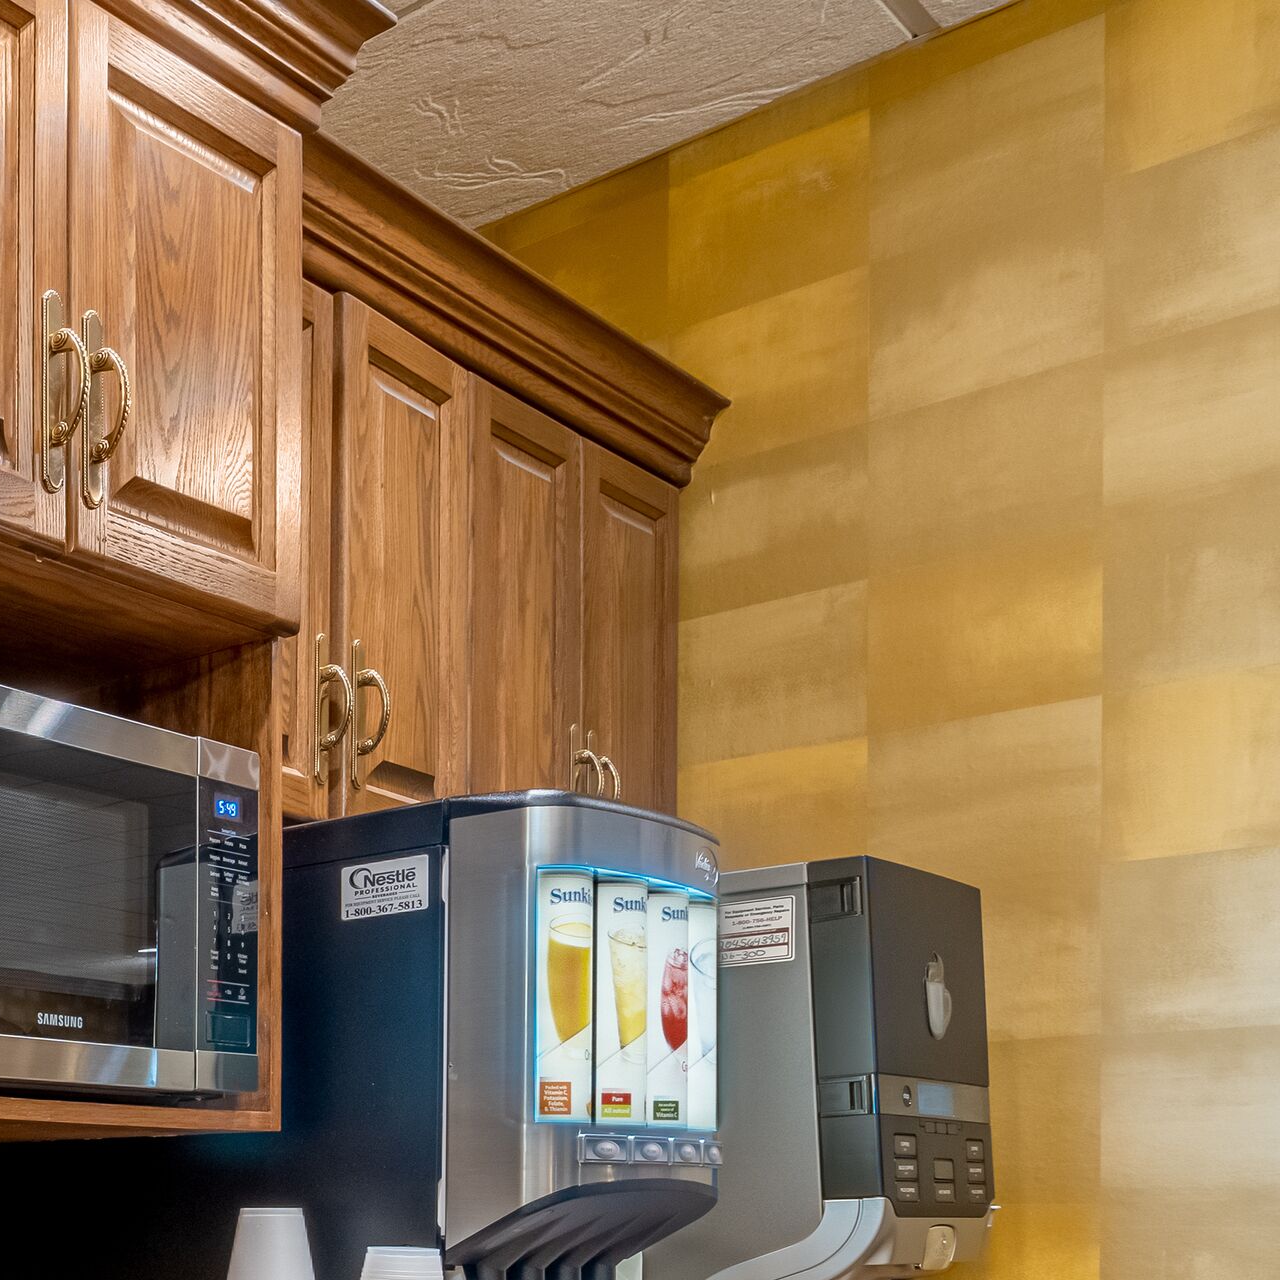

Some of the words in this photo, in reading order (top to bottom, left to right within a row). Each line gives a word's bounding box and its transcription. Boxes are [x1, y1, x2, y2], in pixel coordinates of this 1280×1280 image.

[218, 800, 236, 817] 5:49
[354, 882, 421, 897] PROFESSIONAL
[344, 899, 424, 919] 1-800-367-5813
[37, 1012, 83, 1029] SAMSUNG
